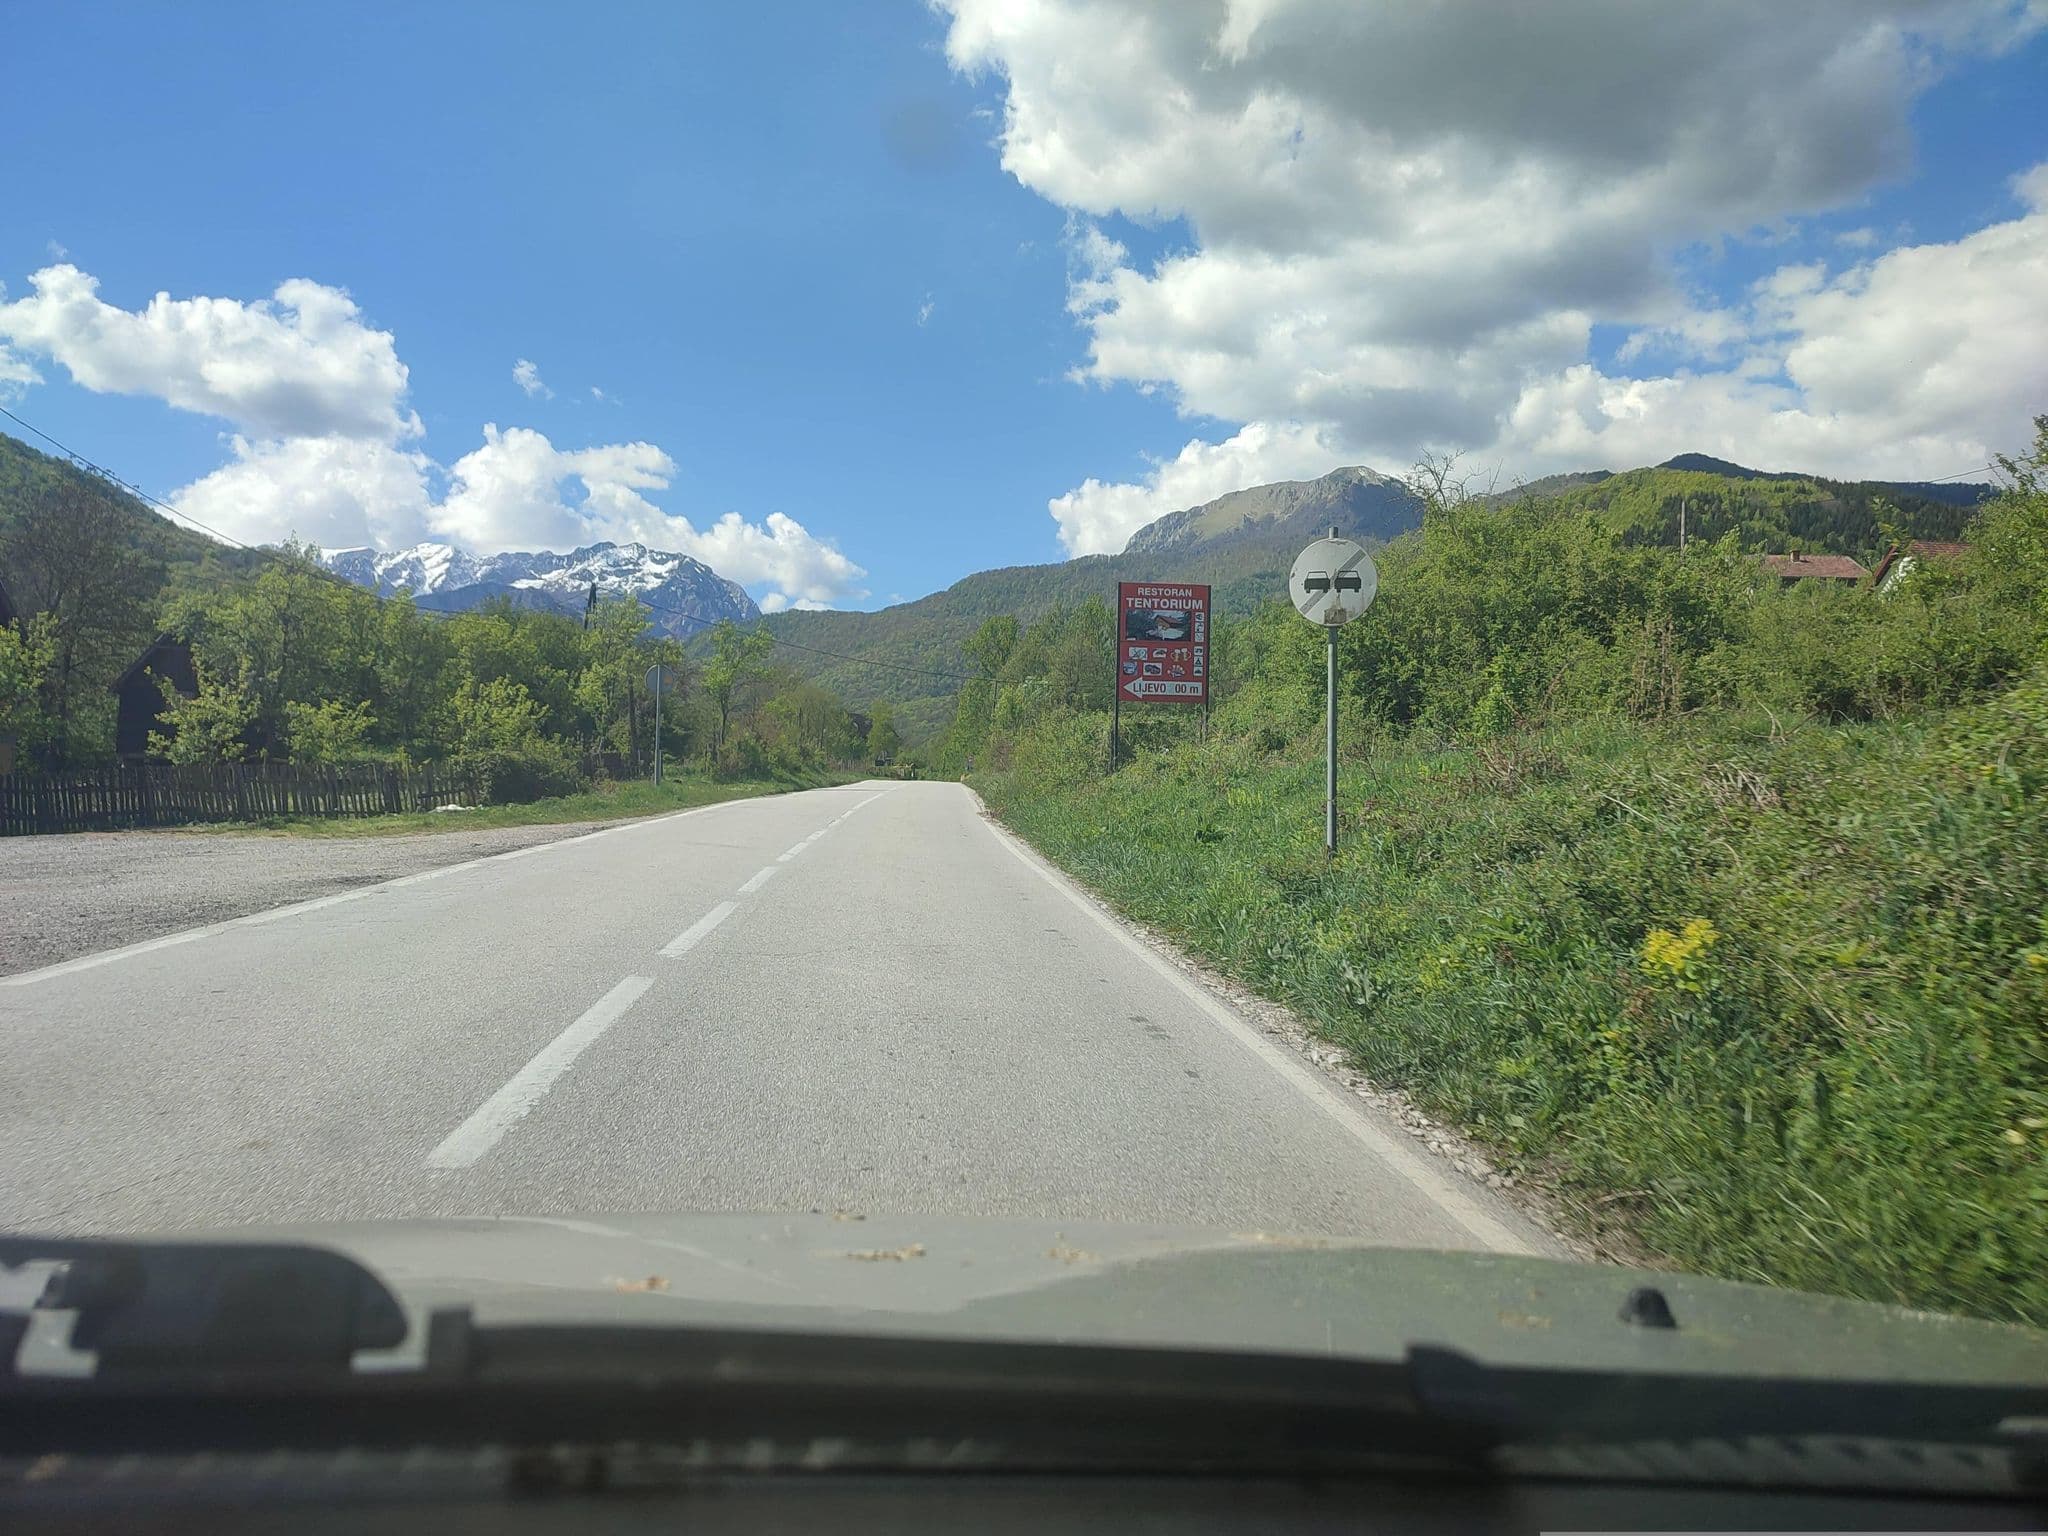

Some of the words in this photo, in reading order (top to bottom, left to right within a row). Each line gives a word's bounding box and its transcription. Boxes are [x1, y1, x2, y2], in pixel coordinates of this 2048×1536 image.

[1137, 587, 1192, 597] RESTORAN
[1126, 597, 1203, 609] TENTORIUM
[1133, 682, 1167, 693] LIJEVO
[1189, 686, 1199, 694] m
